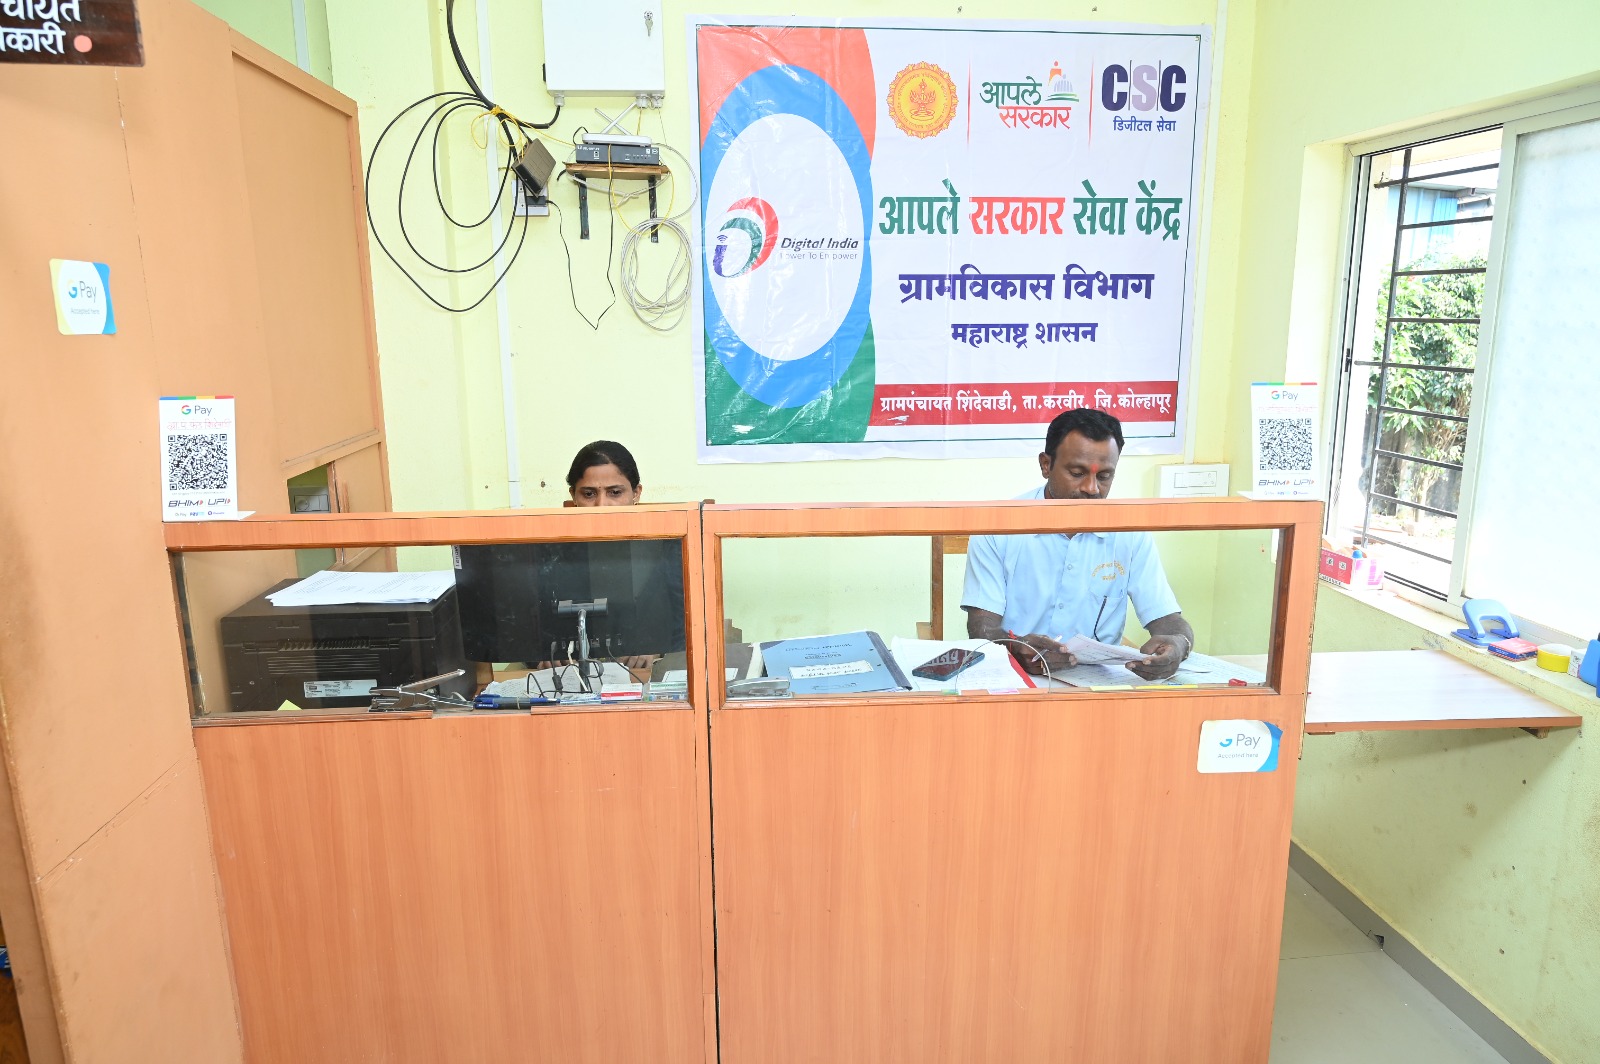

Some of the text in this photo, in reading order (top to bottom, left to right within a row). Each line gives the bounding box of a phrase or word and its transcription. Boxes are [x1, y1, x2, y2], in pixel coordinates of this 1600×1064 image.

[0, 21, 66, 54] कारी
[979, 76, 1042, 107] आपले
[1102, 63, 1187, 112] CSC
[998, 106, 1071, 129] सरकार
[1113, 116, 1176, 132] डिजीटल सेवा
[878, 178, 1183, 241] आपले सरकार सेवा केंद्र
[780, 237, 859, 252] Digital India
[808, 251, 818, 260] To
[79, 280, 97, 303] Pay
[898, 263, 1155, 303] ग्रामविकास विभाग
[950, 322, 1098, 349] महाराष्ट्र शासन
[880, 390, 953, 412] ग्रामपंचायत
[956, 389, 1017, 412] शिंदेवाडी,
[1094, 387, 1172, 414] जि.कोल्हापूर
[1282, 390, 1299, 402] Pay
[181, 404, 213, 416] G Pay
[168, 498, 227, 508] BHIM UPI
[1236, 733, 1261, 749] Pay
